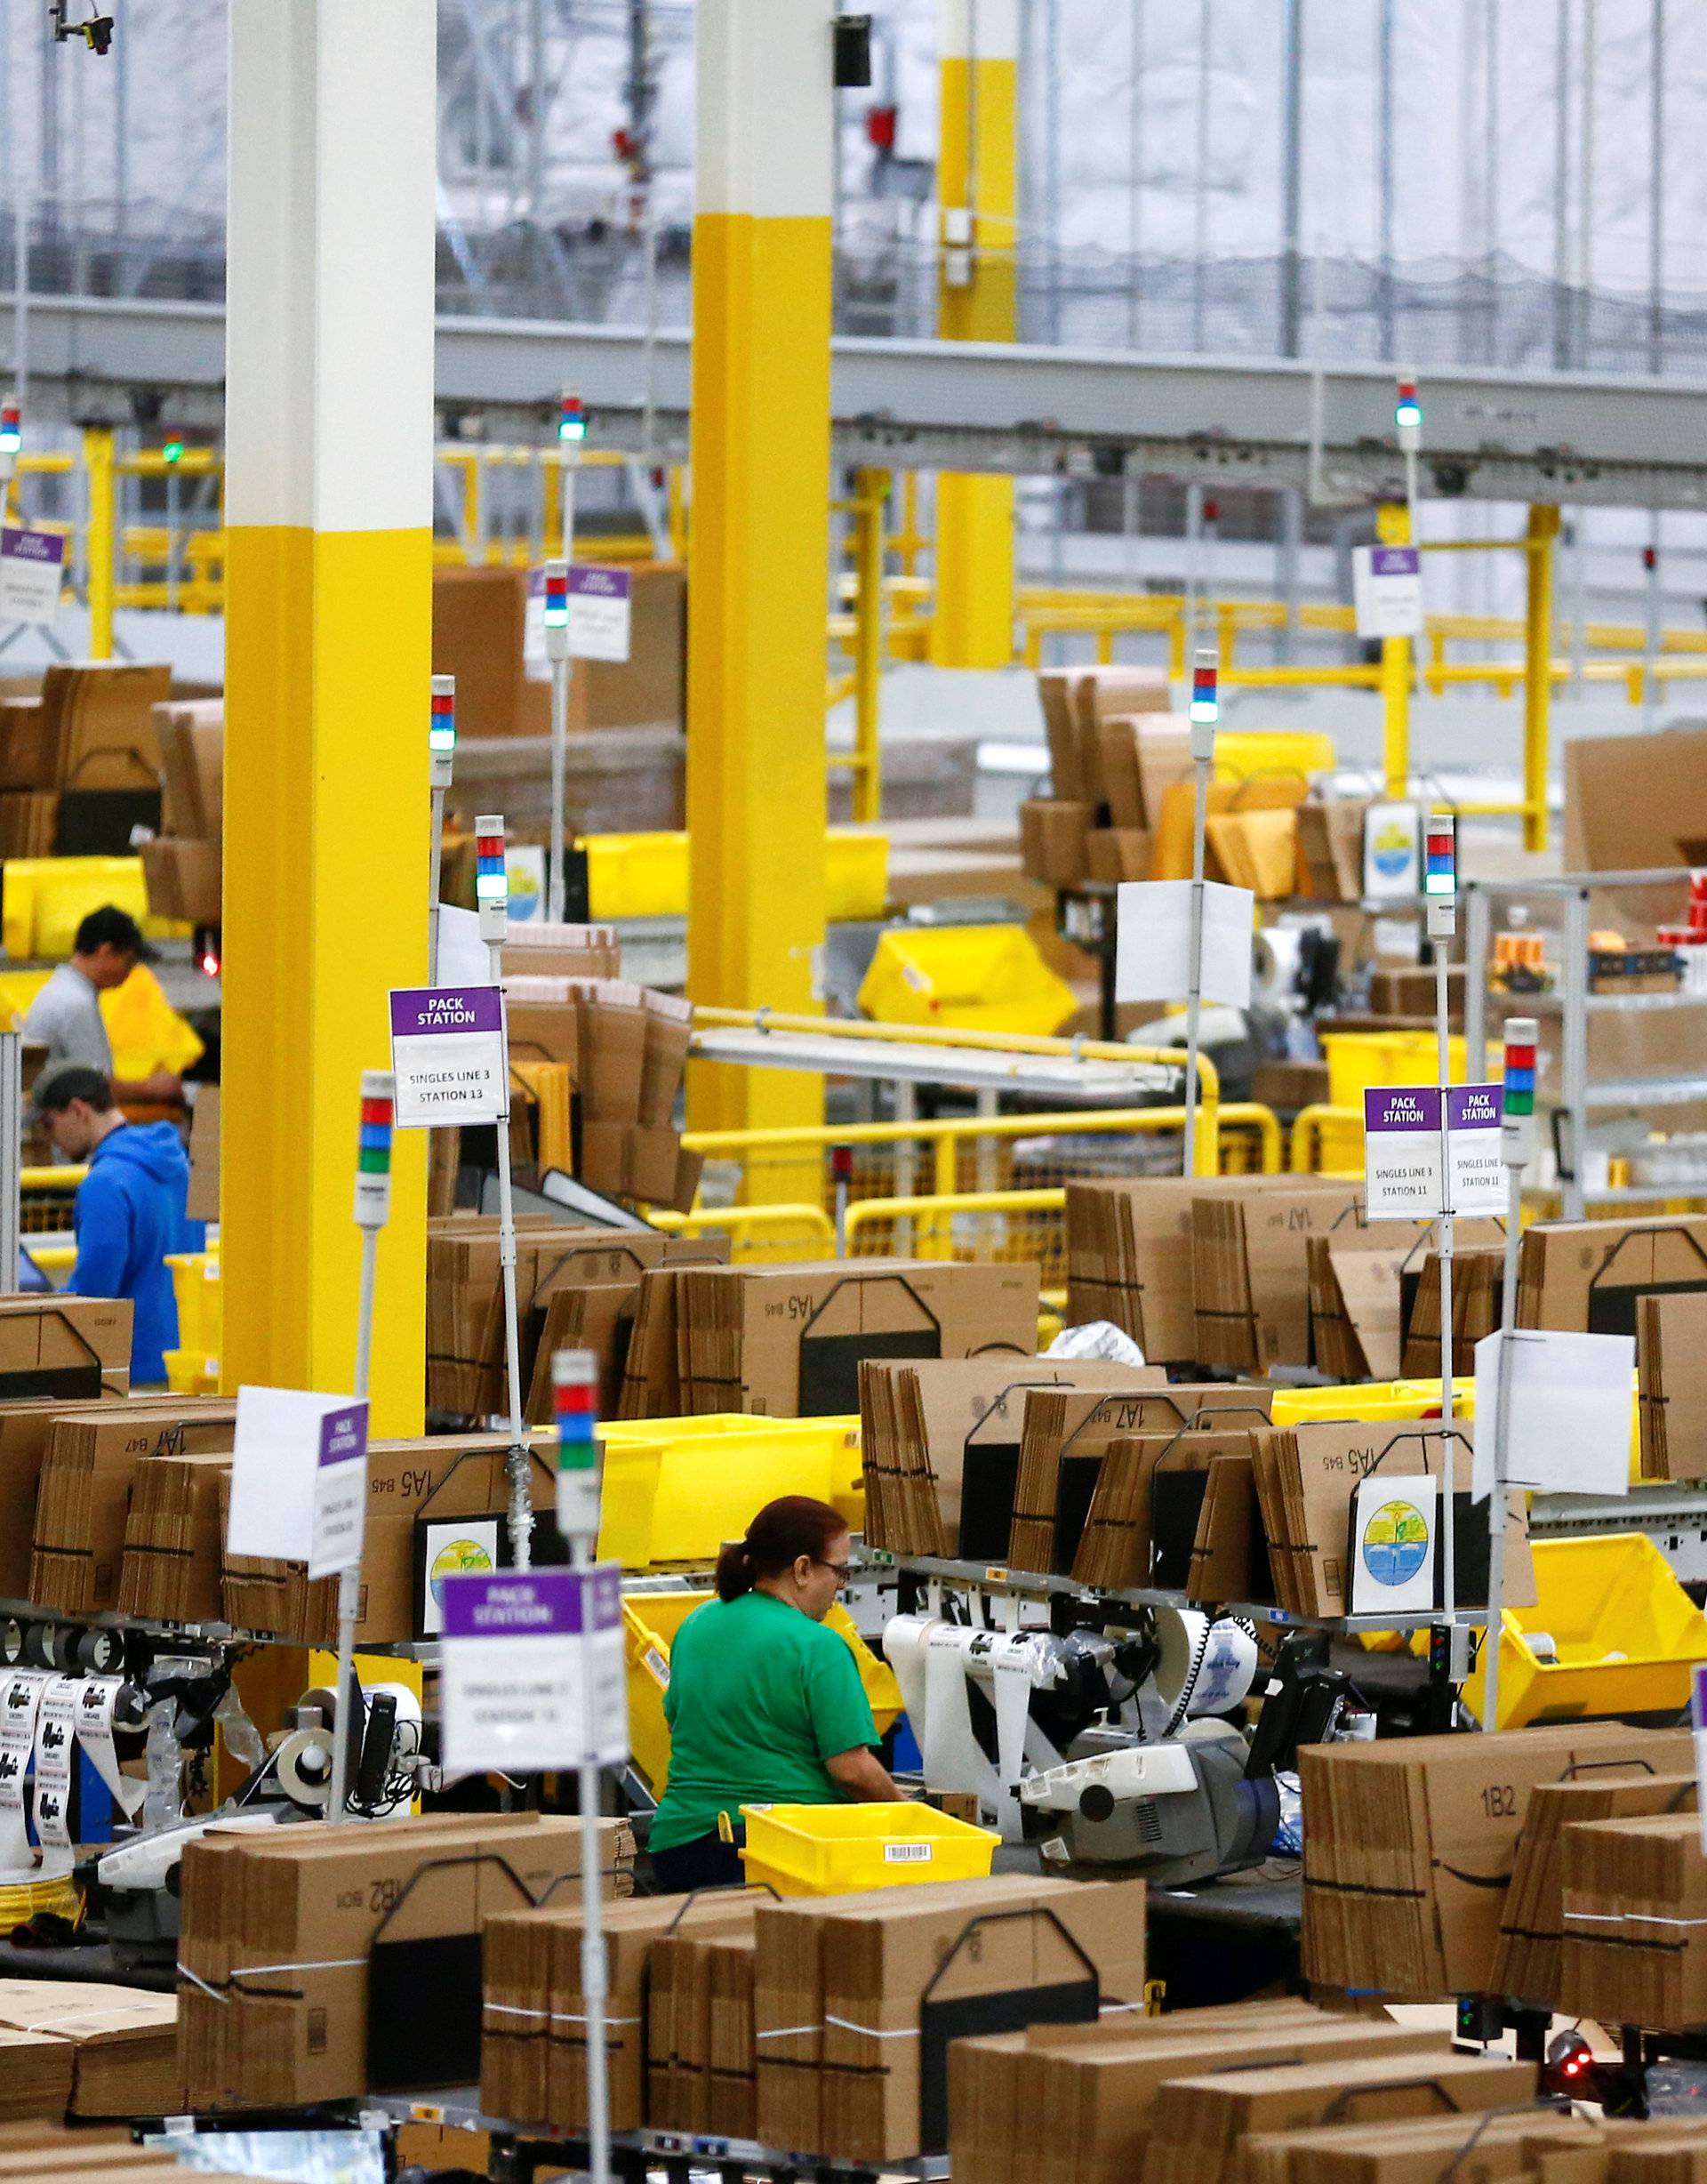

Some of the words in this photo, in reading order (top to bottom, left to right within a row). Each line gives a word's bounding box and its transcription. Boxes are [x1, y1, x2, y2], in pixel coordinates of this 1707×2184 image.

[429, 997, 464, 1011] PACK
[417, 1010, 476, 1025] STATION
[409, 1072, 454, 1085] SINGLES
[457, 1071, 482, 1081] LINE
[484, 1070, 490, 1080] 3
[419, 1090, 467, 1103] STATION
[470, 1089, 483, 1100] 13
[1390, 1096, 1416, 1110] PACK
[1468, 1094, 1490, 1107] PACK
[1382, 1110, 1424, 1123] STATION
[1462, 1107, 1496, 1120] STATION
[1457, 1159, 1483, 1169] SINGLES
[1484, 1158, 1499, 1168] LINE
[1375, 1168, 1407, 1180] SINGLES
[1408, 1168, 1426, 1177] LINE
[1428, 1167, 1432, 1176] 3
[1462, 1177, 1490, 1187] STATION
[1491, 1176, 1499, 1185] 11
[1382, 1186, 1416, 1197] STATION
[1418, 1185, 1427, 1195] 11
[789, 1295, 813, 1320] 1A5
[1115, 1403, 1145, 1429] 1A7
[125, 1437, 148, 1452] B47
[1322, 1456, 1343, 1470] B45
[1348, 1448, 1378, 1474] 1A5
[372, 1478, 395, 1493] B45
[401, 1469, 431, 1497] 1A5
[1480, 1785, 1517, 1818] 1B2
